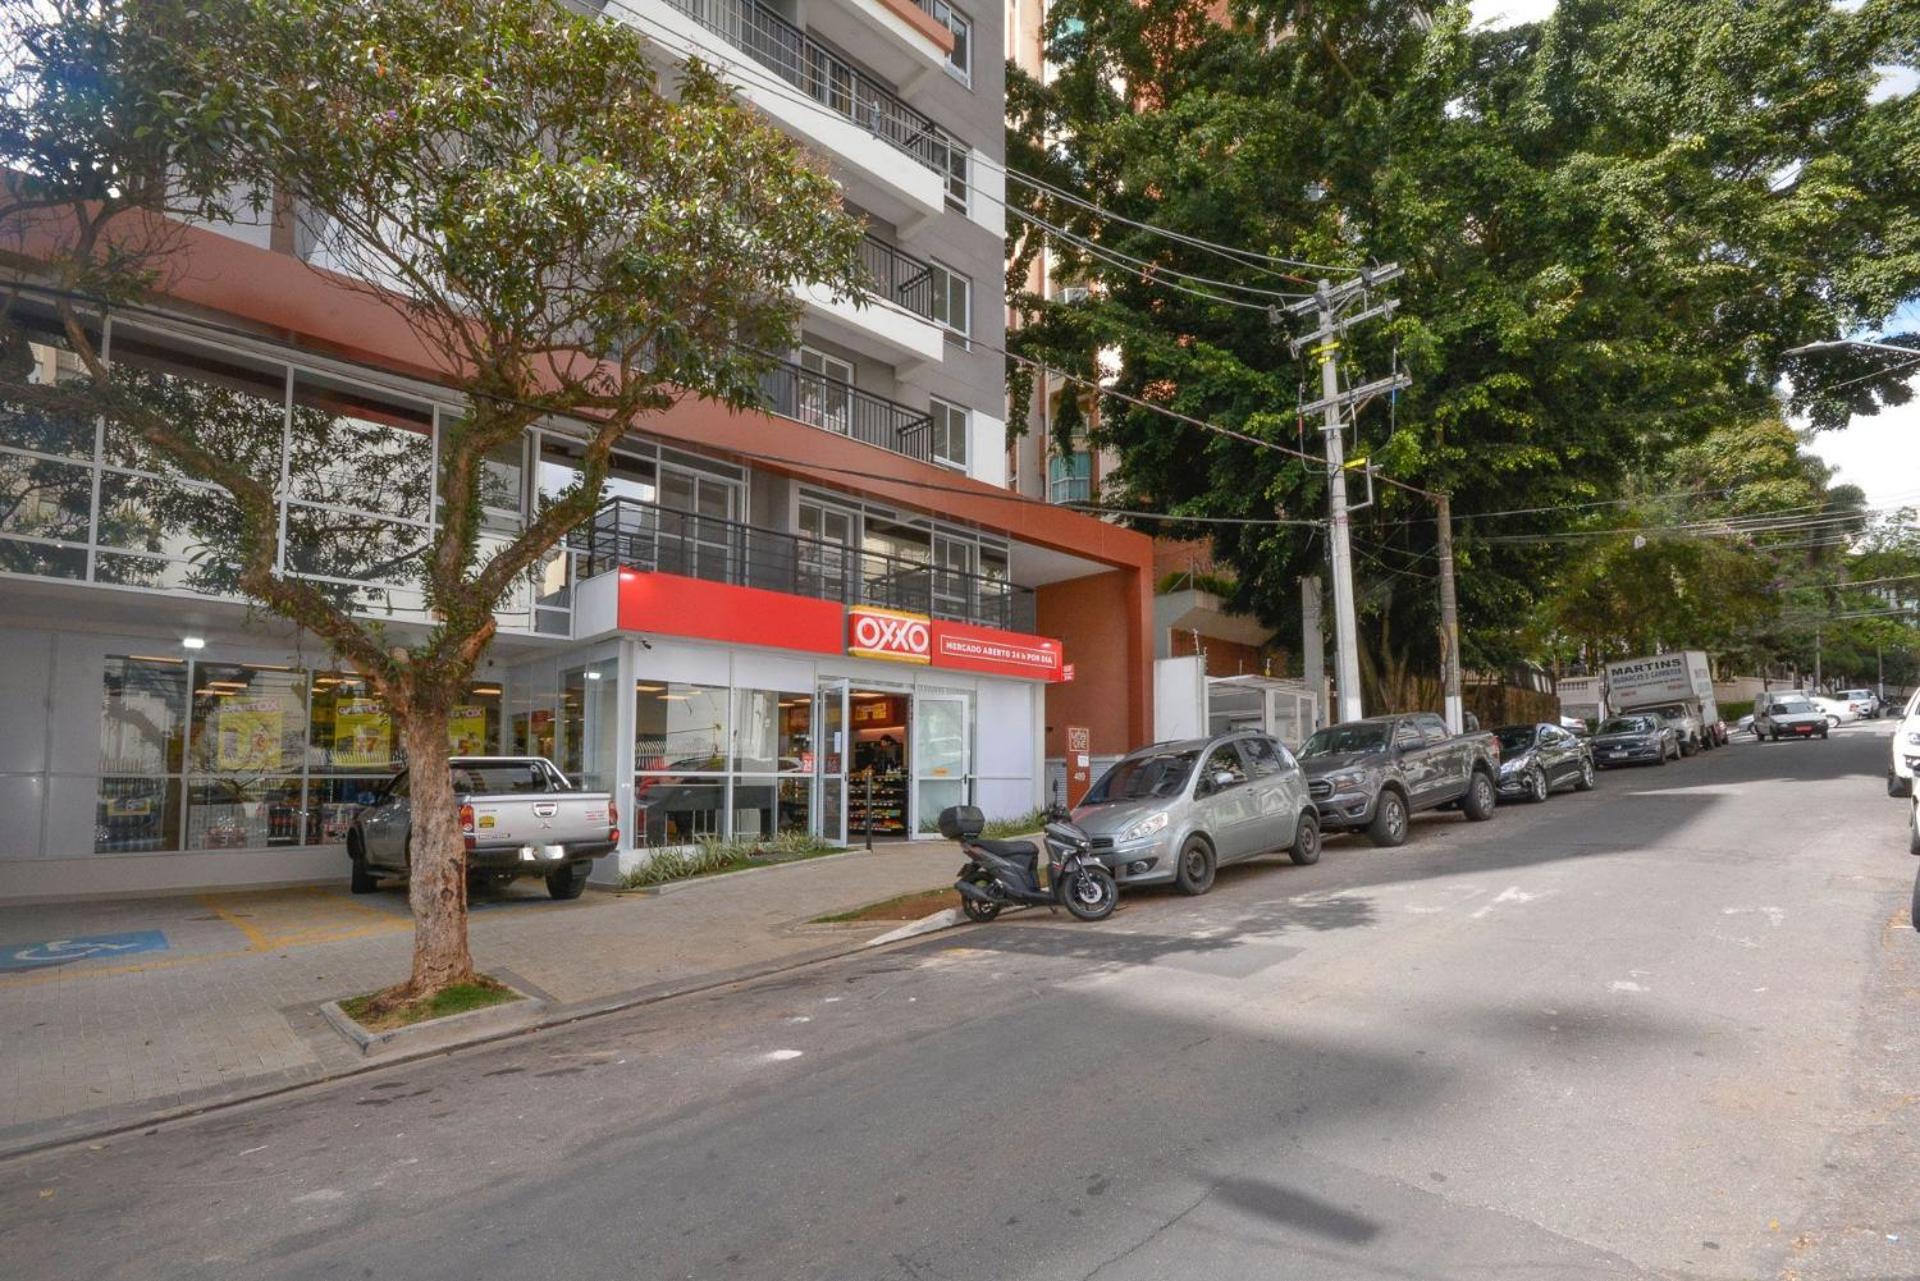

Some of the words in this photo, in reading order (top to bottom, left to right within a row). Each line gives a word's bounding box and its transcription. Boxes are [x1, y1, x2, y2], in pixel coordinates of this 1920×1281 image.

[857, 617, 929, 652] OXXO
[946, 641, 981, 654] MERCADO
[982, 646, 1010, 658] ABERTO
[1026, 653, 1041, 662] POR
[1041, 655, 1054, 664] DIA
[1611, 659, 1681, 677] MARTINS
